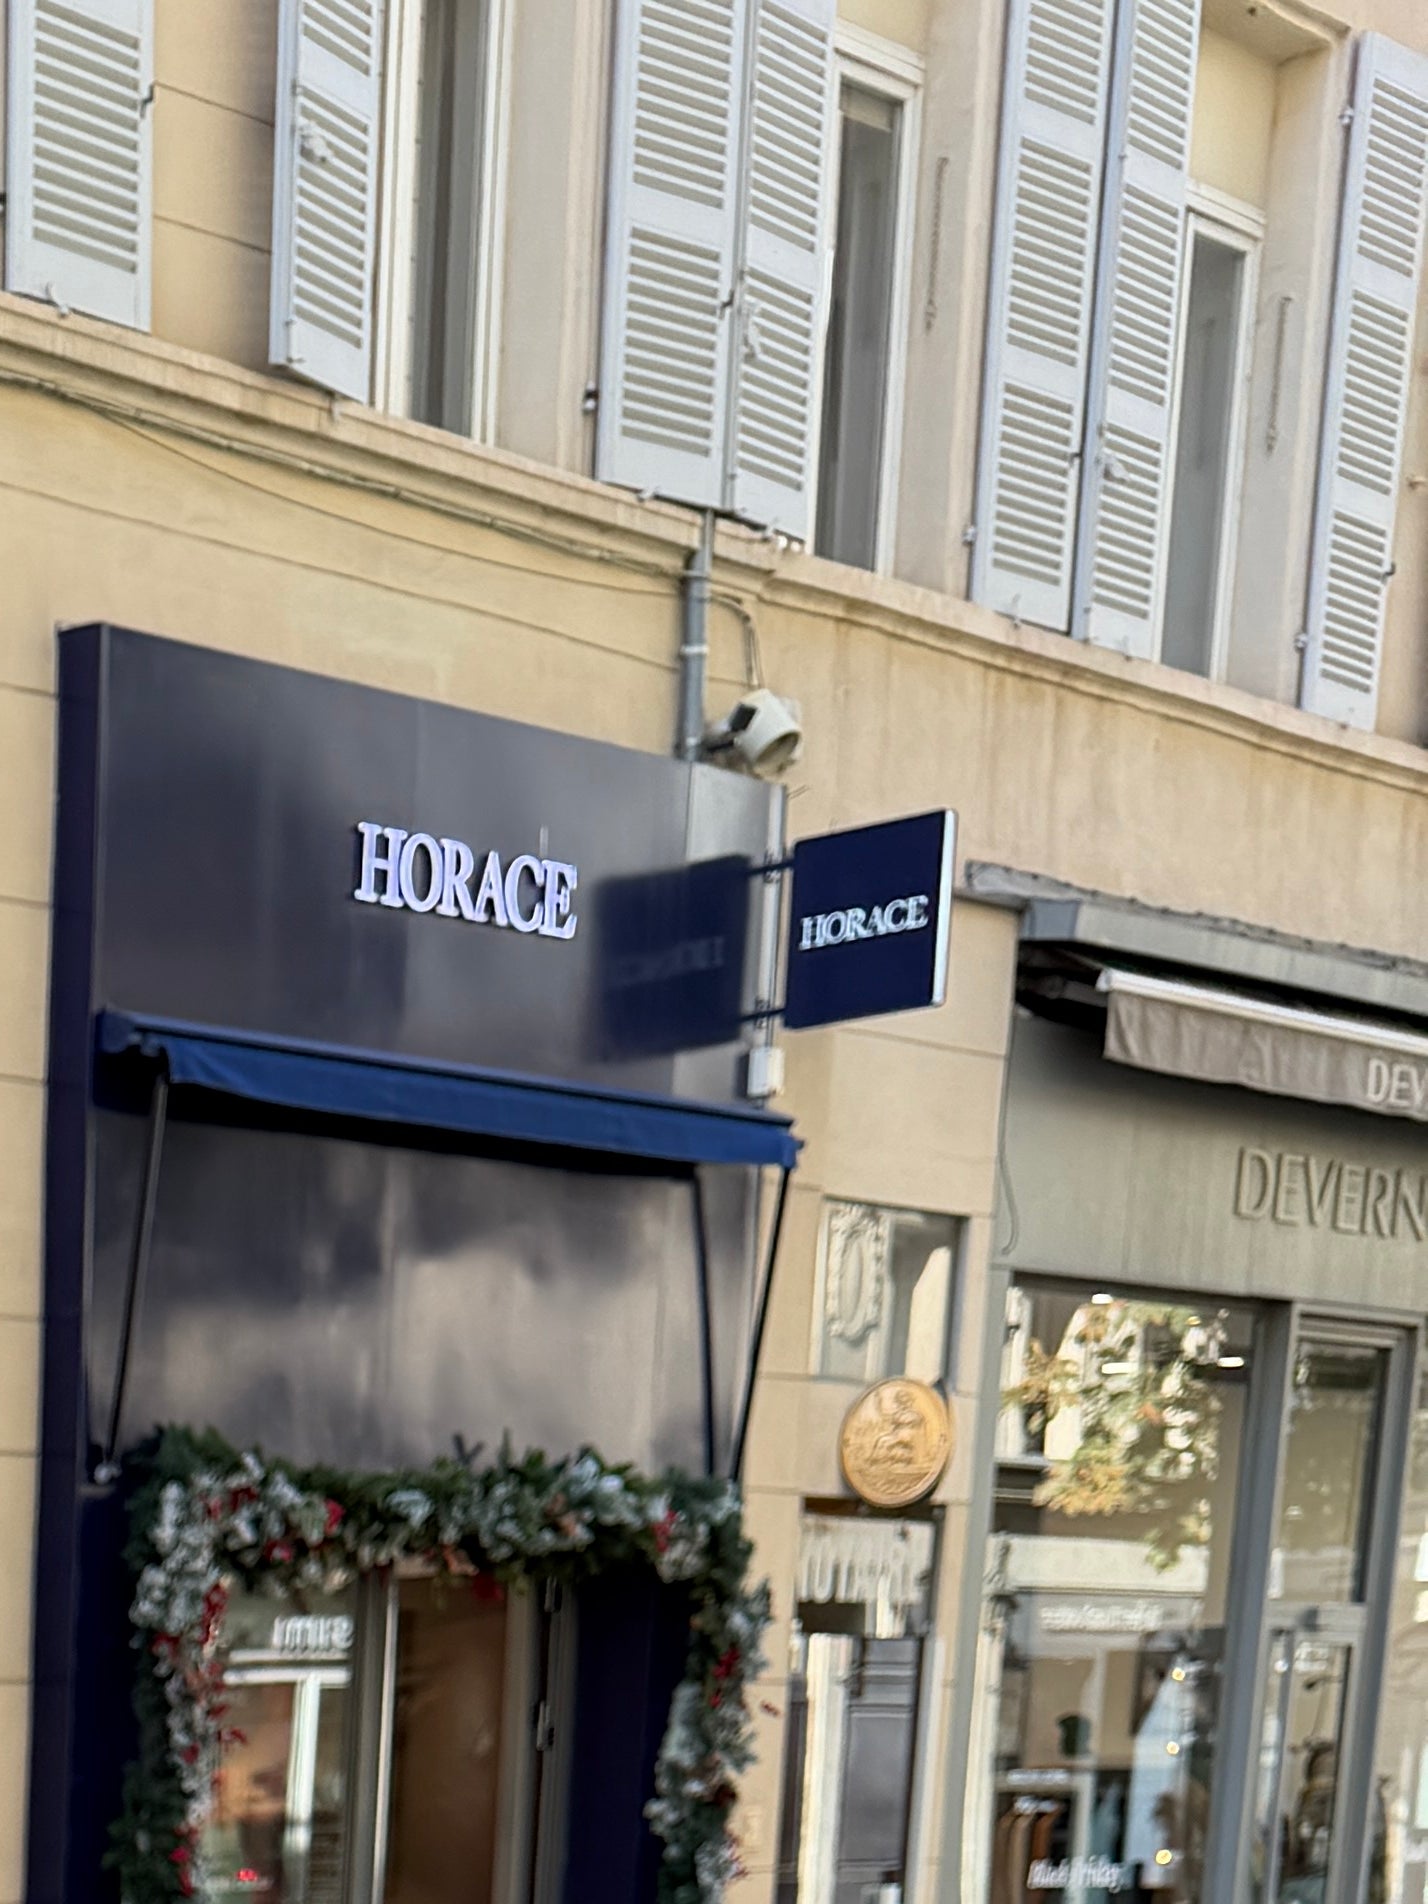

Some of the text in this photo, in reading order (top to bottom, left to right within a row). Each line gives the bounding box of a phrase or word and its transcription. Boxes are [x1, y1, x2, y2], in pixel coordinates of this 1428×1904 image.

[354, 821, 578, 940] HORACE
[798, 894, 929, 951] HORACE
[1234, 1147, 1428, 1242] DEVERN
